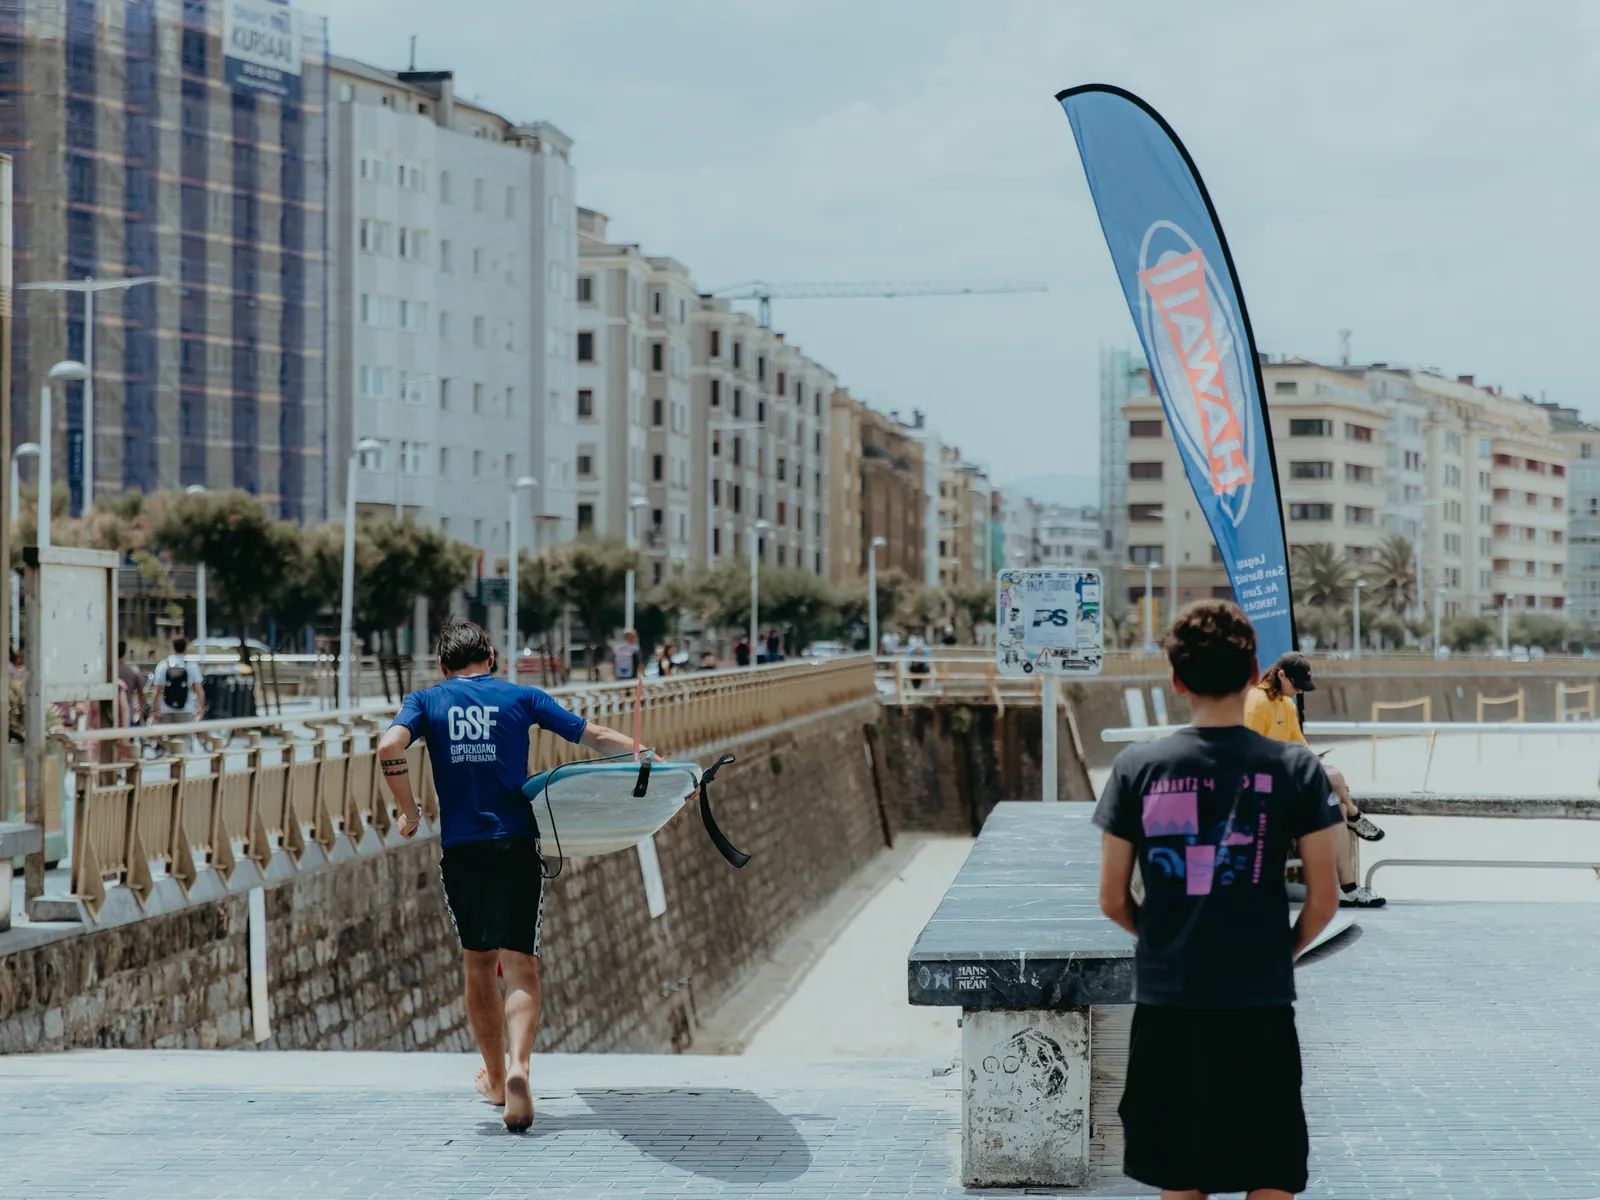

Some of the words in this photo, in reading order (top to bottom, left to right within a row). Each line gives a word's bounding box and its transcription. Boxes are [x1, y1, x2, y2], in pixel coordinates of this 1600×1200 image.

[448, 705, 499, 741] GSF
[450, 743, 497, 755] GIPUZKOAKO
[451, 755, 465, 764] SURF
[958, 966, 987, 976] HANS
[958, 979, 987, 990] NEAN
